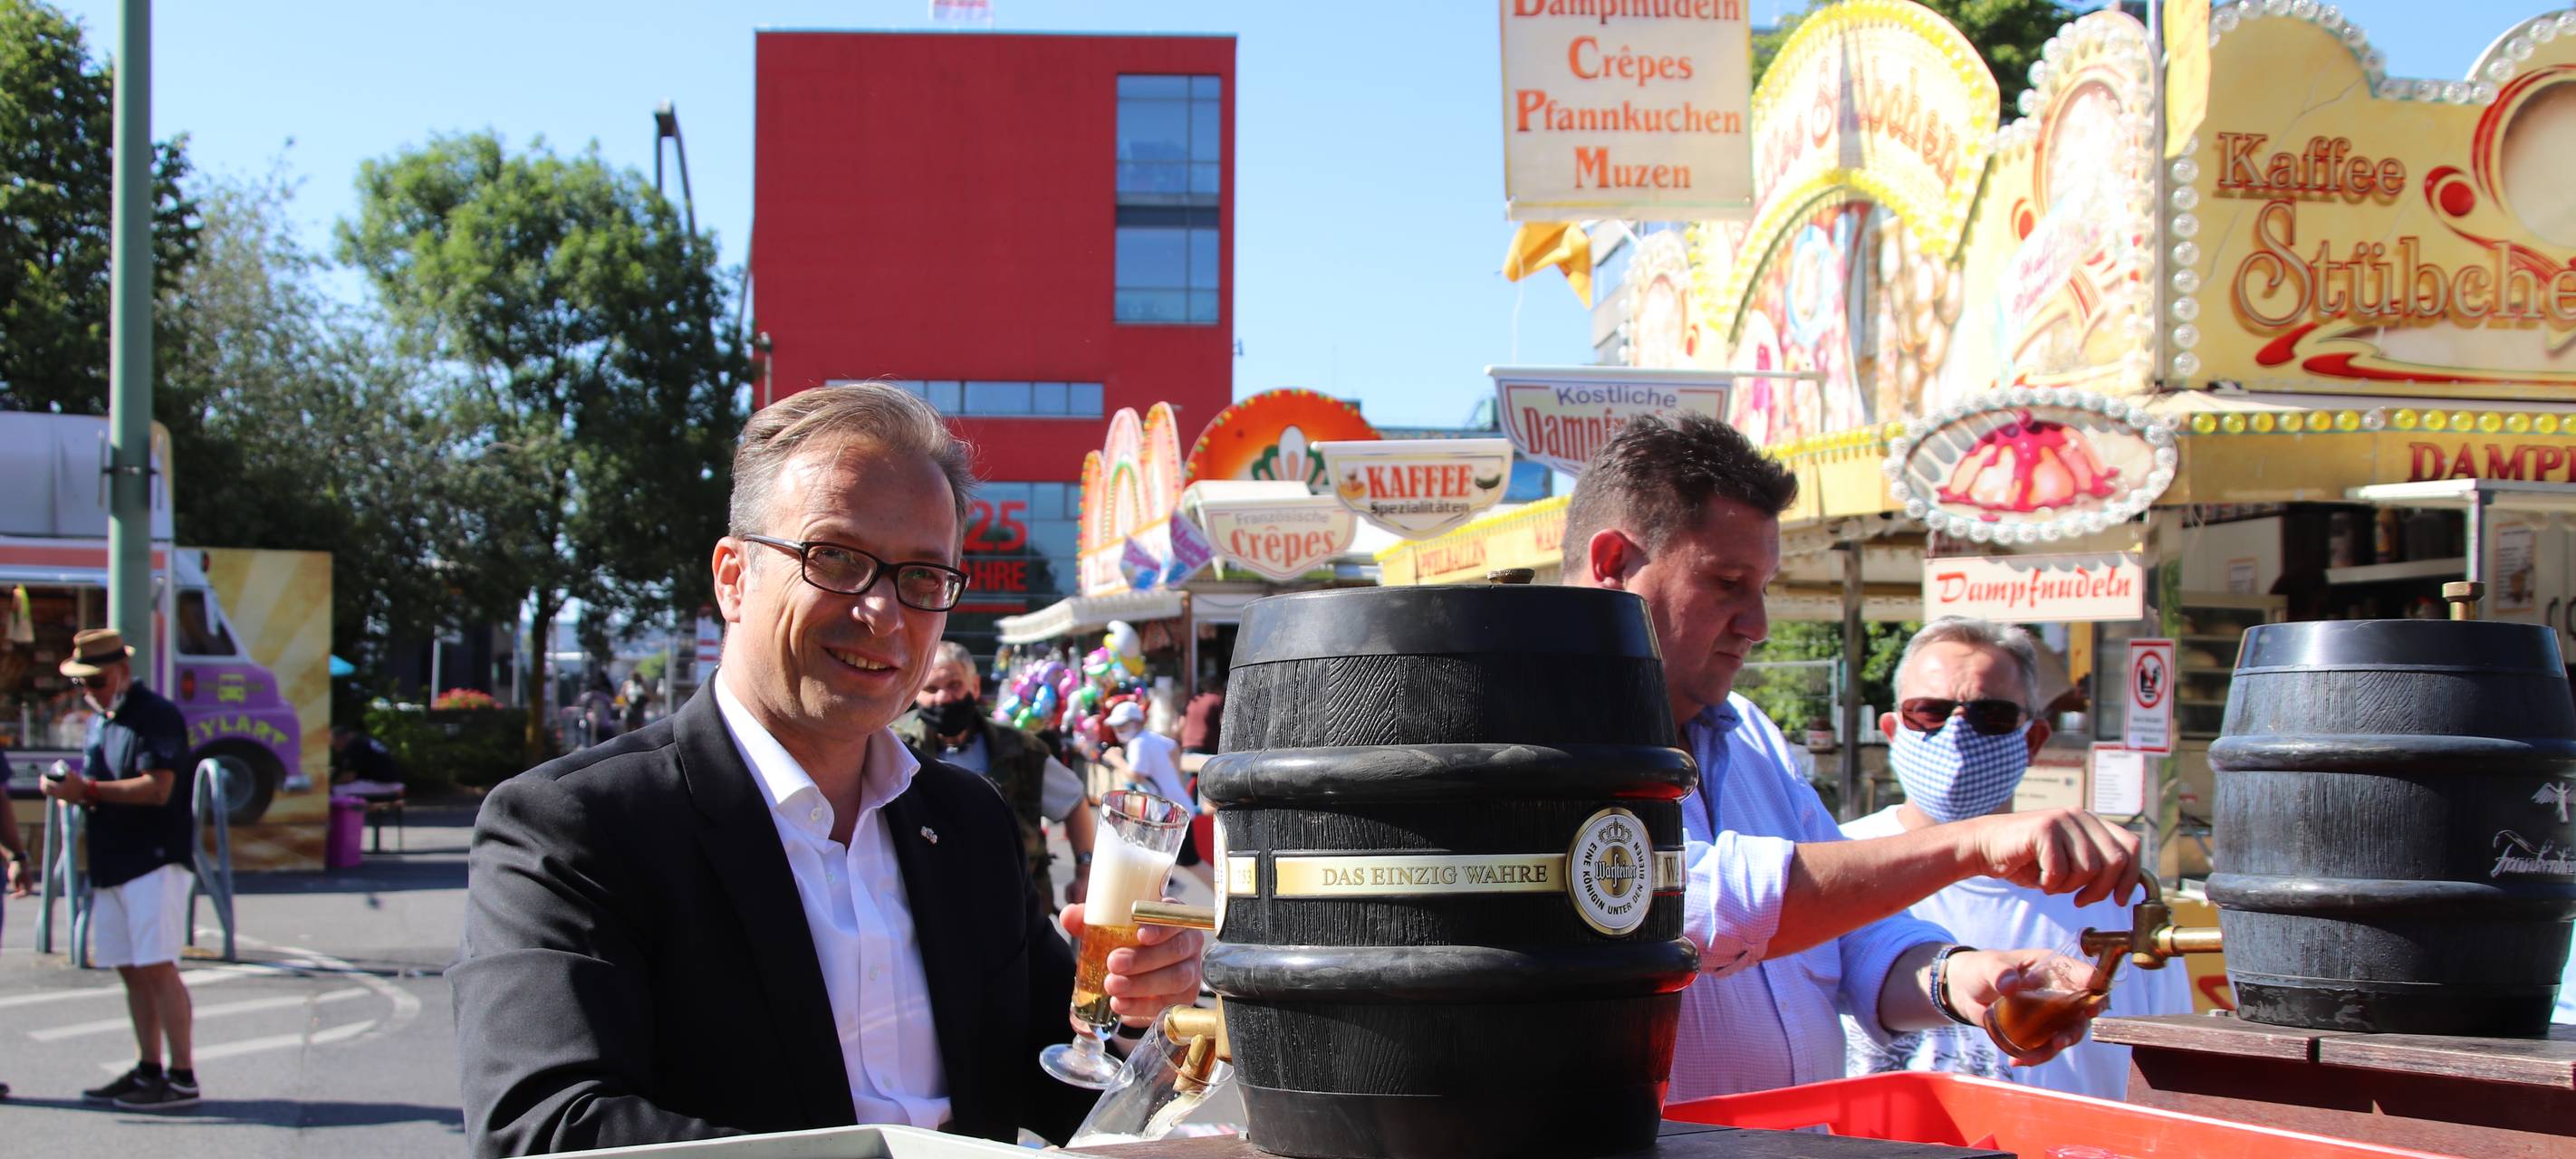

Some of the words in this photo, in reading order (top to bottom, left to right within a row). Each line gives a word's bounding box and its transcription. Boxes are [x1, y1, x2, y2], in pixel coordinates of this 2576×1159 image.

[1568, 35, 1694, 86] Crêpes
[1515, 89, 1742, 132] Pfannkuchen
[1574, 146, 1692, 188] Muzen
[2217, 132, 2408, 196] Kaffee
[1556, 385, 1677, 407] Köstliche
[1365, 465, 1472, 499] KAFFEE
[1234, 509, 1330, 525] Französische
[1370, 501, 1470, 516] Spezialitäten
[1231, 525, 1336, 568] Crêpes
[1937, 566, 2131, 608] Dampfnudeln
[1583, 842, 1598, 867] EINE
[1633, 842, 1645, 879] BIEREN
[1322, 867, 1364, 886] DAS
[1370, 866, 1457, 886] EINZIG
[1462, 865, 1549, 884] WAHRE
[1582, 870, 1605, 910] KÖNIGIN
[1607, 902, 1632, 915] UNTER
[1632, 884, 1643, 904] DEN
